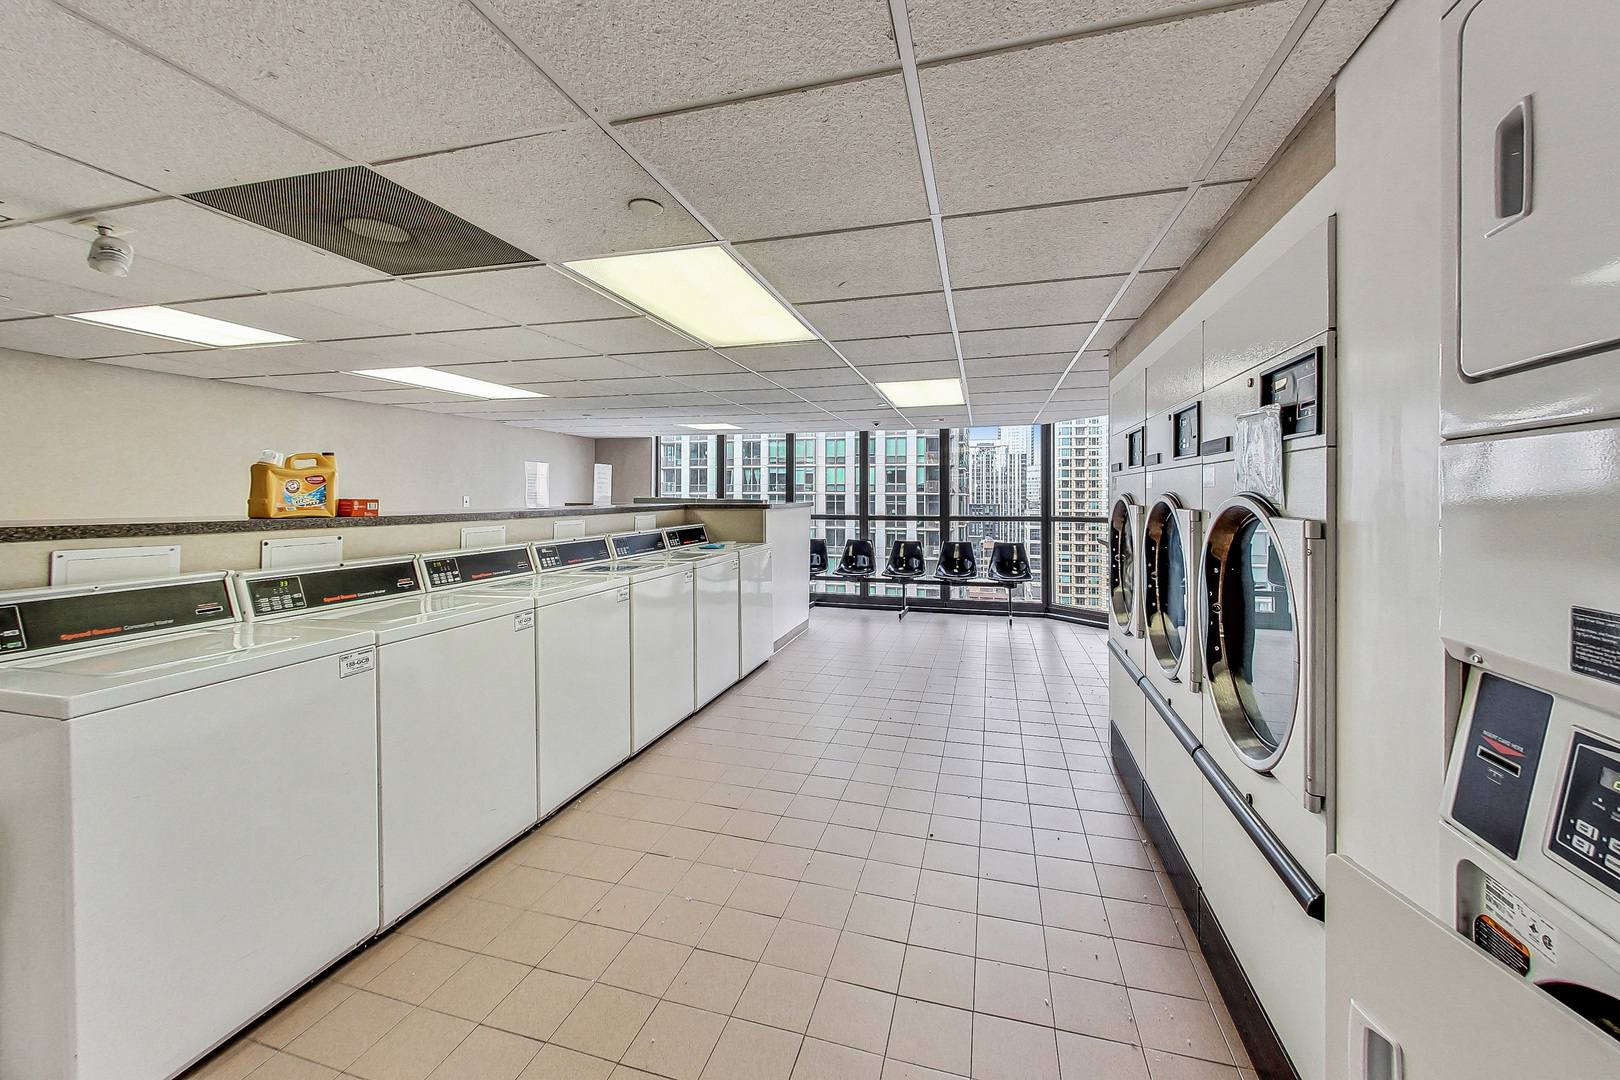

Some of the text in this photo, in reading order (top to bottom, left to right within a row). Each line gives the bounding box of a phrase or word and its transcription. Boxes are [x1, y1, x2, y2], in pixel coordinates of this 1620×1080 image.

[61, 629, 91, 640] Speed
[1483, 730, 1498, 740] INSERT
[1498, 737, 1511, 747] CARD
